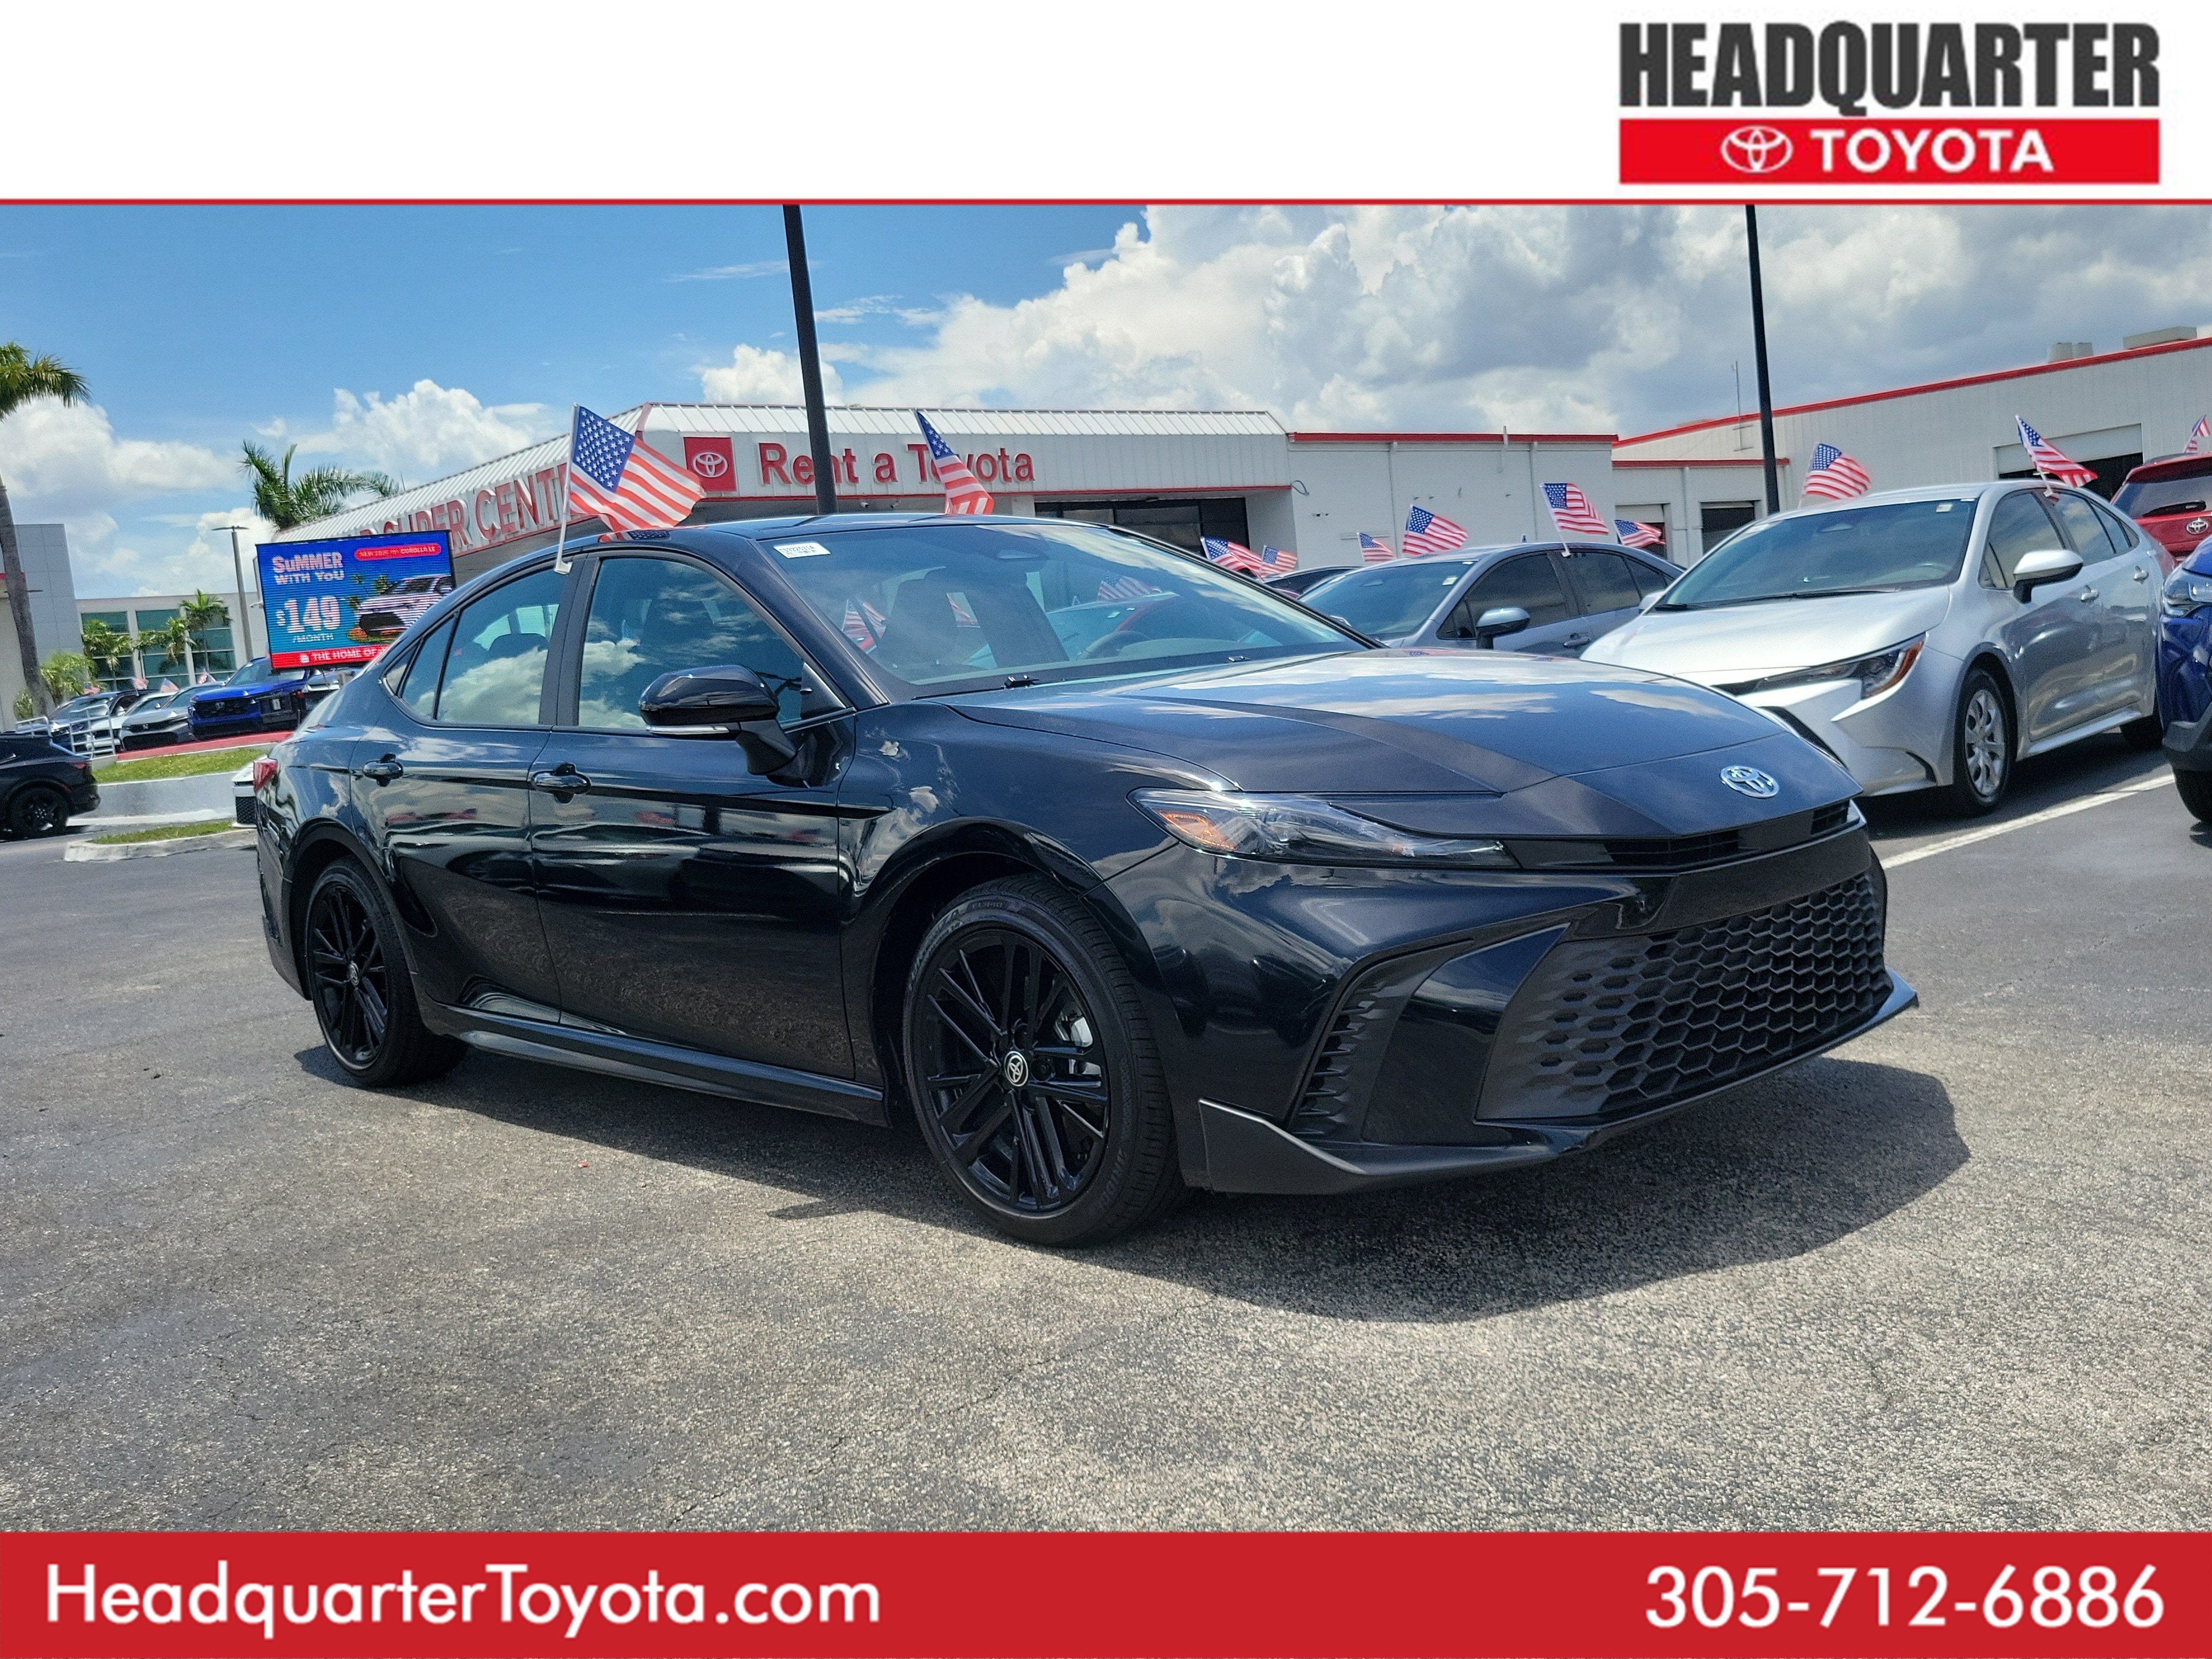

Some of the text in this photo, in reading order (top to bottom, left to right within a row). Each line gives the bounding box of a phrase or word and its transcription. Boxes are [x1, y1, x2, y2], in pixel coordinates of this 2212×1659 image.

[873, 453, 898, 483] a
[312, 652, 331, 661] THE
[333, 650, 362, 659] HOME
[363, 648, 376, 657] OF
